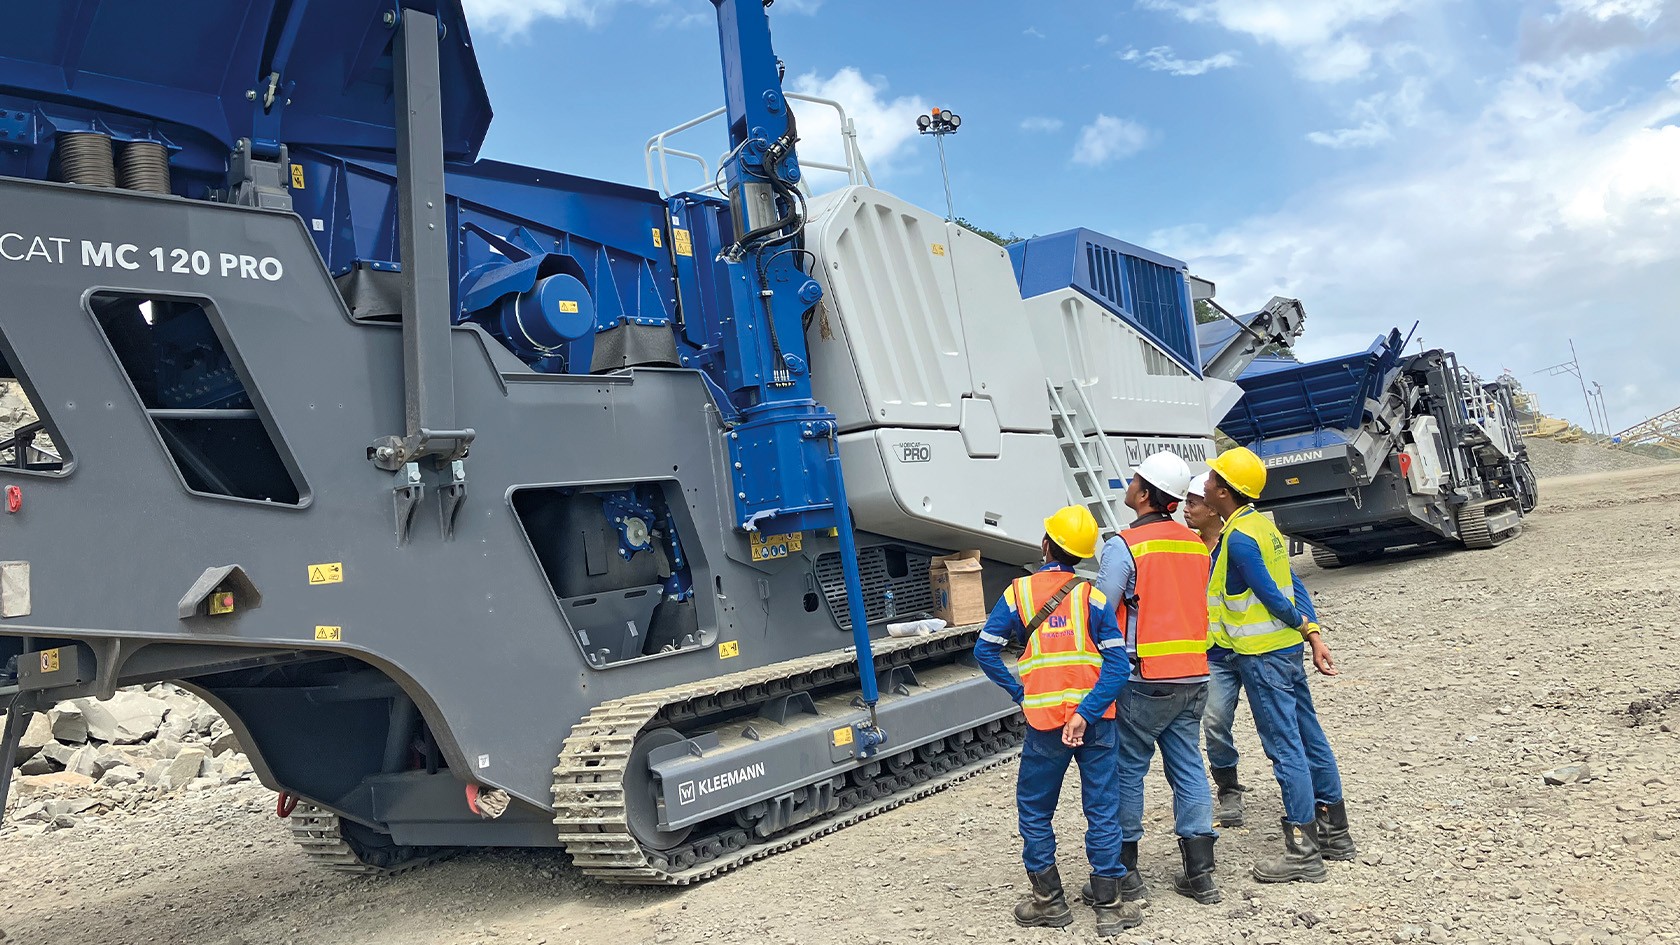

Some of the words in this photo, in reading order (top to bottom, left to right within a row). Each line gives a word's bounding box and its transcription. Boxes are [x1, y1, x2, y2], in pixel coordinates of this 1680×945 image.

[81, 240, 140, 270] MC
[149, 247, 211, 276] 120
[219, 252, 283, 281] PRO
[903, 447, 929, 460] PRO
[1263, 450, 1323, 467] LEEMANN
[1049, 615, 1067, 628] GM
[698, 762, 765, 795] KLEEMANN
